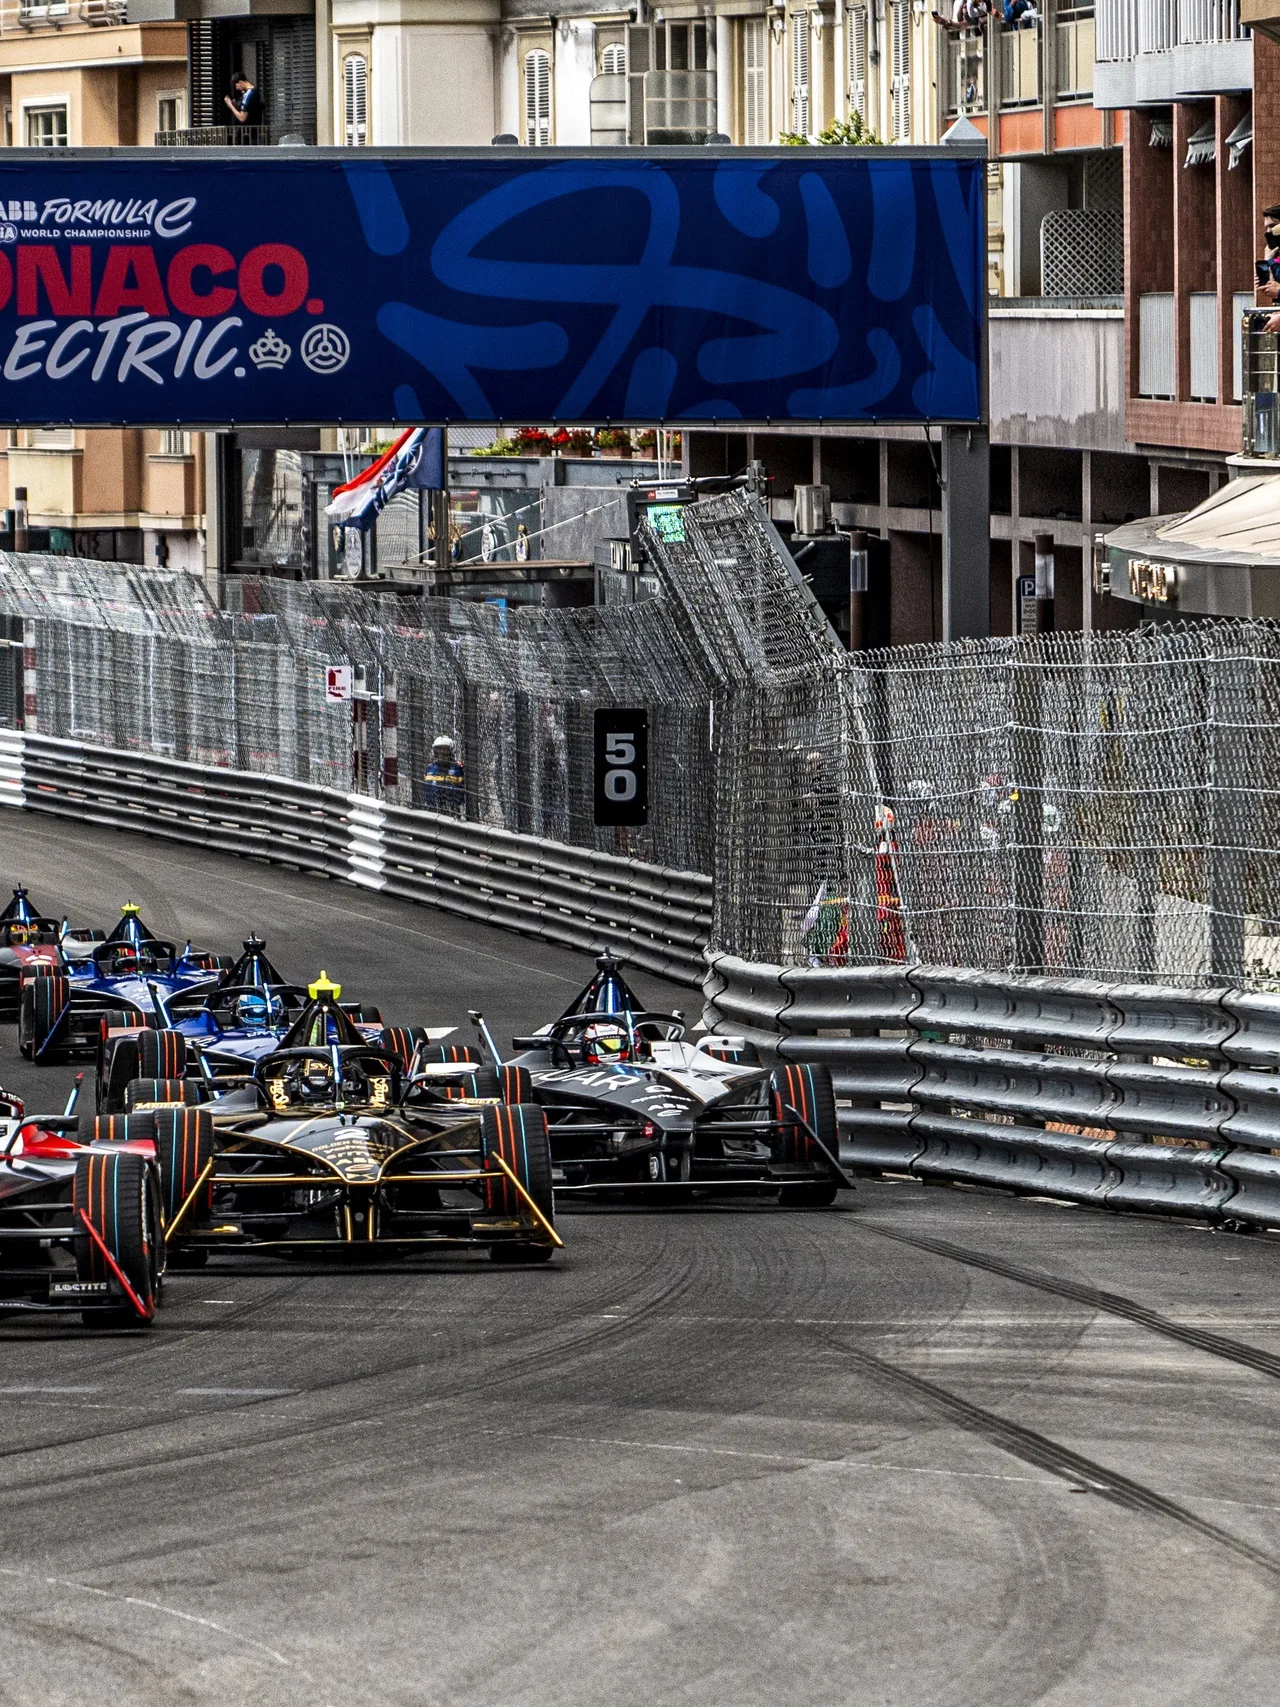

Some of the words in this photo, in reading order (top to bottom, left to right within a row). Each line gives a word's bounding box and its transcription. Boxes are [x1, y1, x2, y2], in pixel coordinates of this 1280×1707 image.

[40, 197, 158, 225] FORMULA
[21, 229, 60, 238] WORLD
[64, 229, 151, 238] CHAMPIONSHIP
[604, 732, 637, 801] 50
[55, 1282, 107, 1291] LOCTITE
